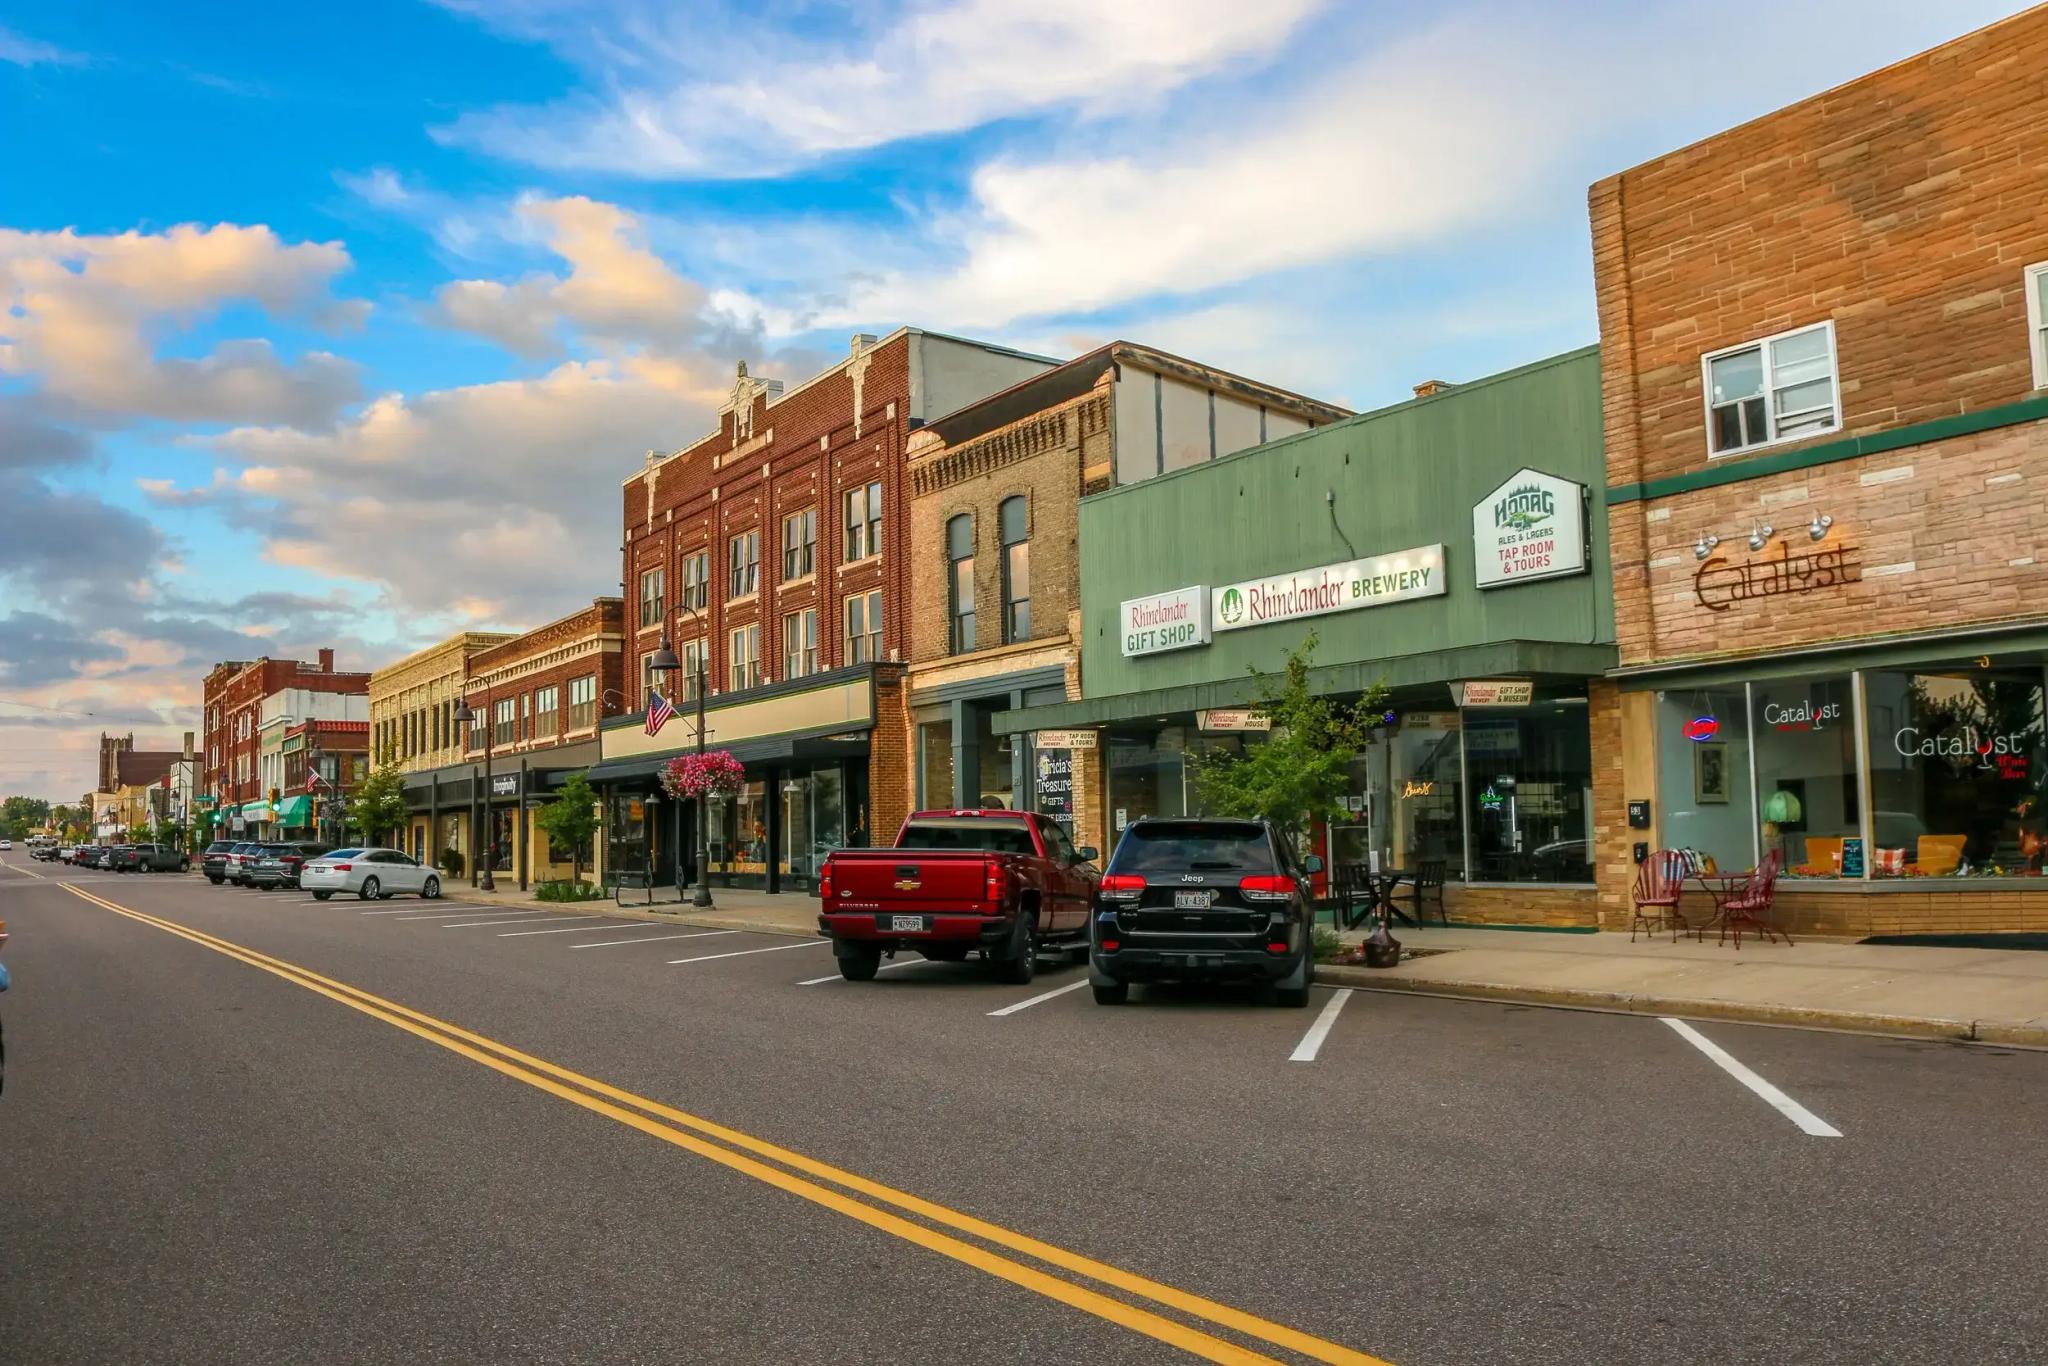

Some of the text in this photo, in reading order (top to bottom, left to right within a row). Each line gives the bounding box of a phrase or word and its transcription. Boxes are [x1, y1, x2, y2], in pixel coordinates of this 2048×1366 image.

[1494, 490, 1554, 527] HODAG
[1498, 527, 1554, 546] ALES & LAGERS
[1499, 540, 1554, 561] TAP ROOM
[1503, 555, 1551, 574] & TOURS
[1693, 541, 1862, 612] Catalyst
[1249, 567, 1431, 621] Rhinelander BREWERY
[1132, 595, 1188, 629] Rhinelander
[1127, 623, 1195, 652] GIFT SHOP
[1500, 686, 1529, 695] GIFT SHOP
[1503, 695, 1529, 703] MUSEUM
[1244, 720, 1265, 728] HOUSE
[1764, 700, 1840, 730] Catalyst
[1894, 726, 2023, 769] Catalyst
[1041, 758, 1072, 775] Tricia's
[1047, 796, 1064, 806] GIFTS
[1181, 874, 1204, 883] Jeep
